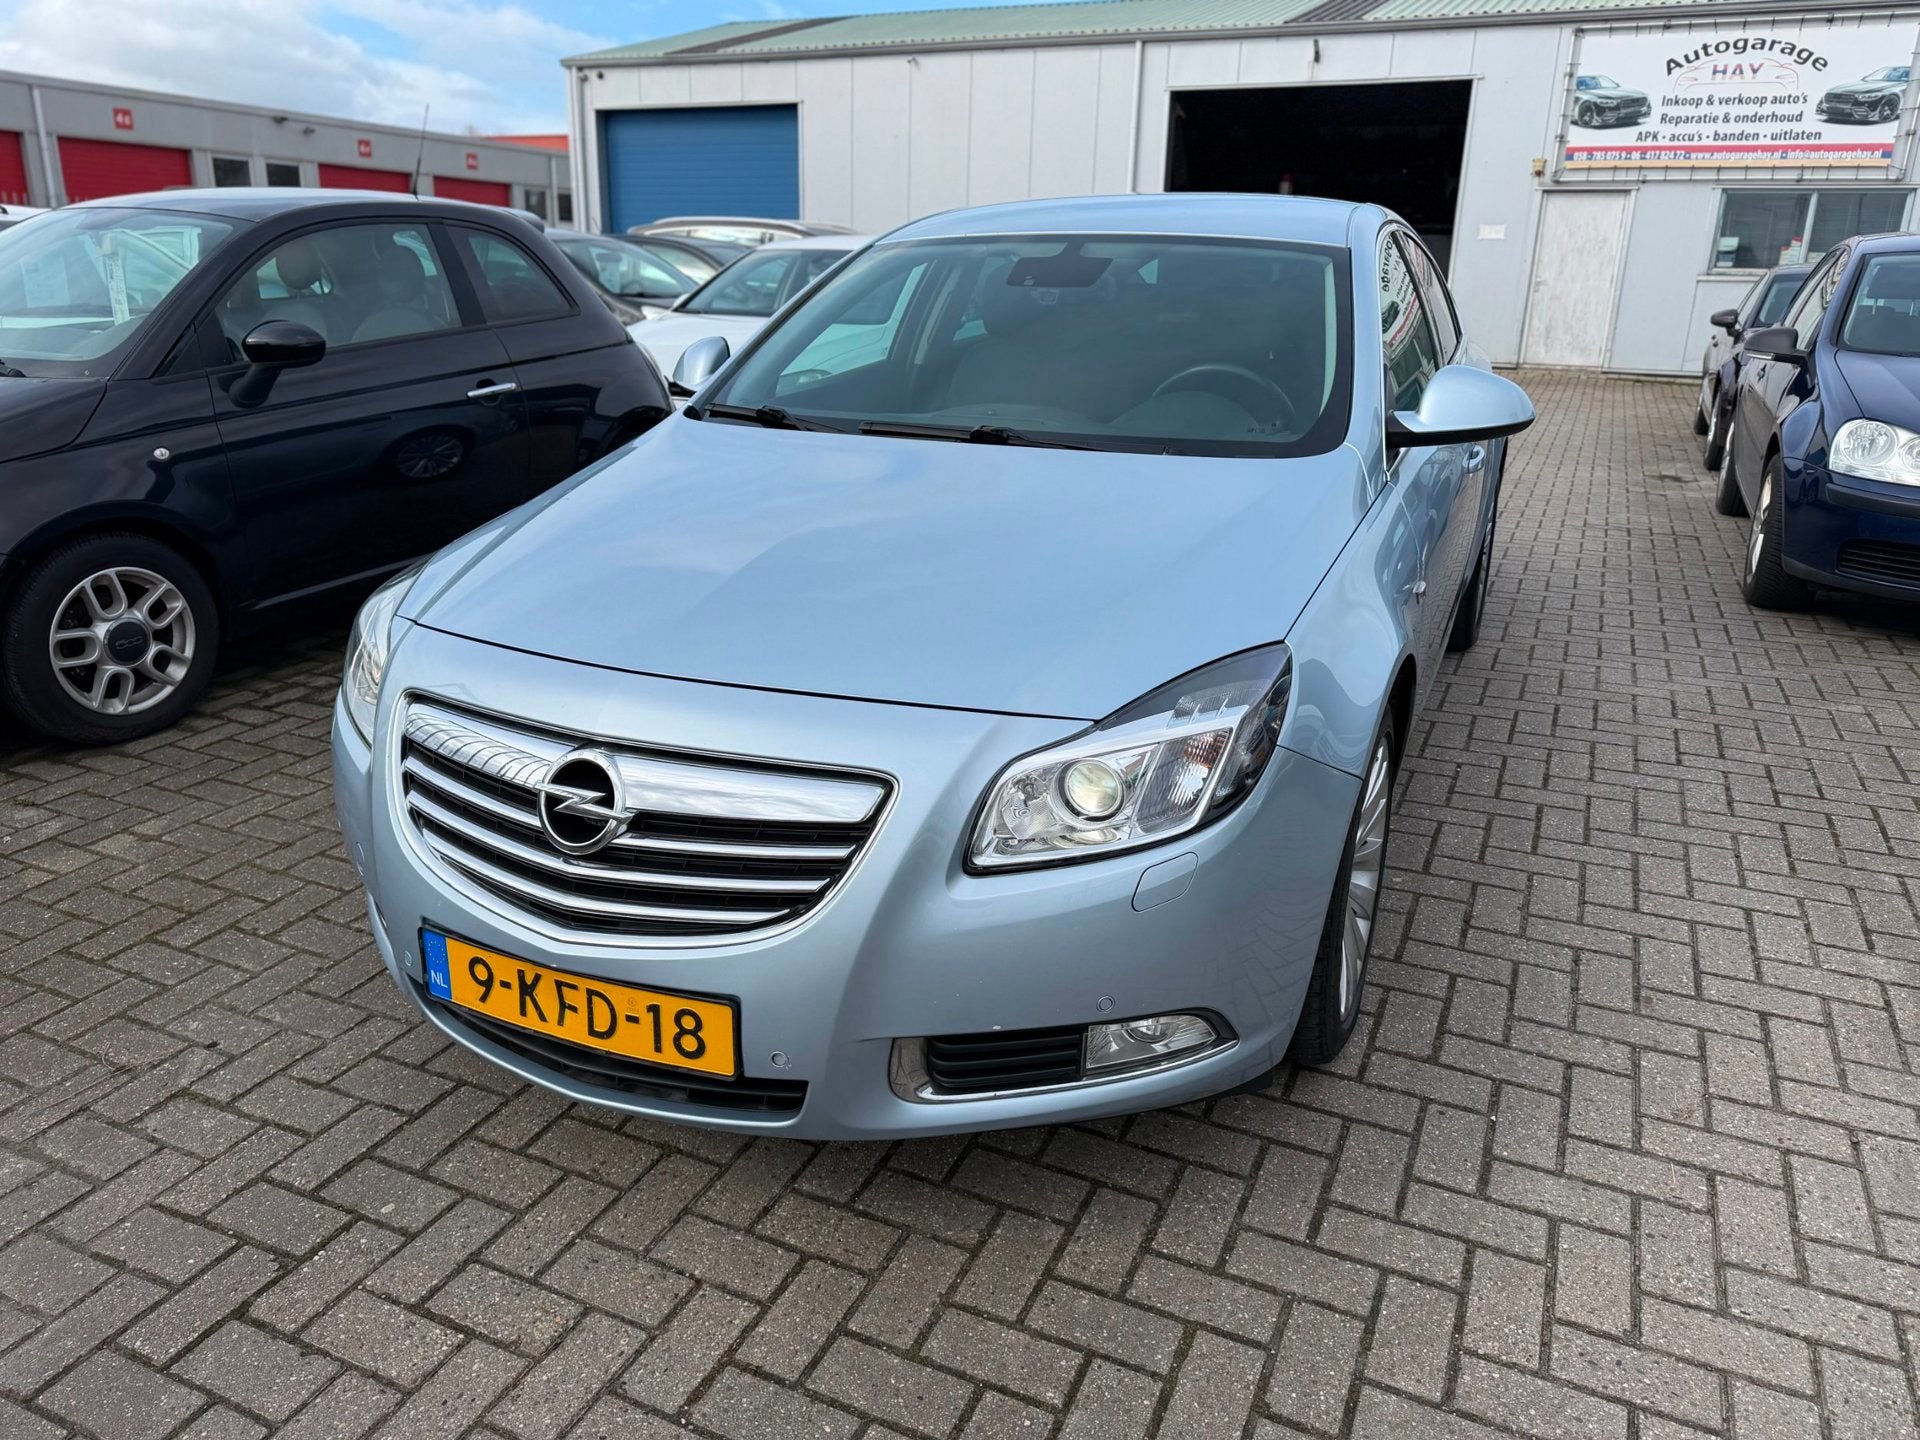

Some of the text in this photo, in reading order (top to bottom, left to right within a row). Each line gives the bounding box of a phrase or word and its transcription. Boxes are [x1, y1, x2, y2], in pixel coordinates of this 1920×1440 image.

[1665, 37, 1829, 77] Autogarage
[1711, 63, 1765, 80] HAY
[1661, 92, 1808, 108] Inkoop & verkoop auto's
[1660, 111, 1803, 127] Reparatie & onderhoud
[1636, 129, 1822, 142] APK accu's banden uitlaten
[1690, 149, 1781, 161] www.autogaragehay.nl
[1787, 148, 1883, 161] info@autogaragehay.nl
[430, 955, 706, 1060] NL 9-KFD-18
